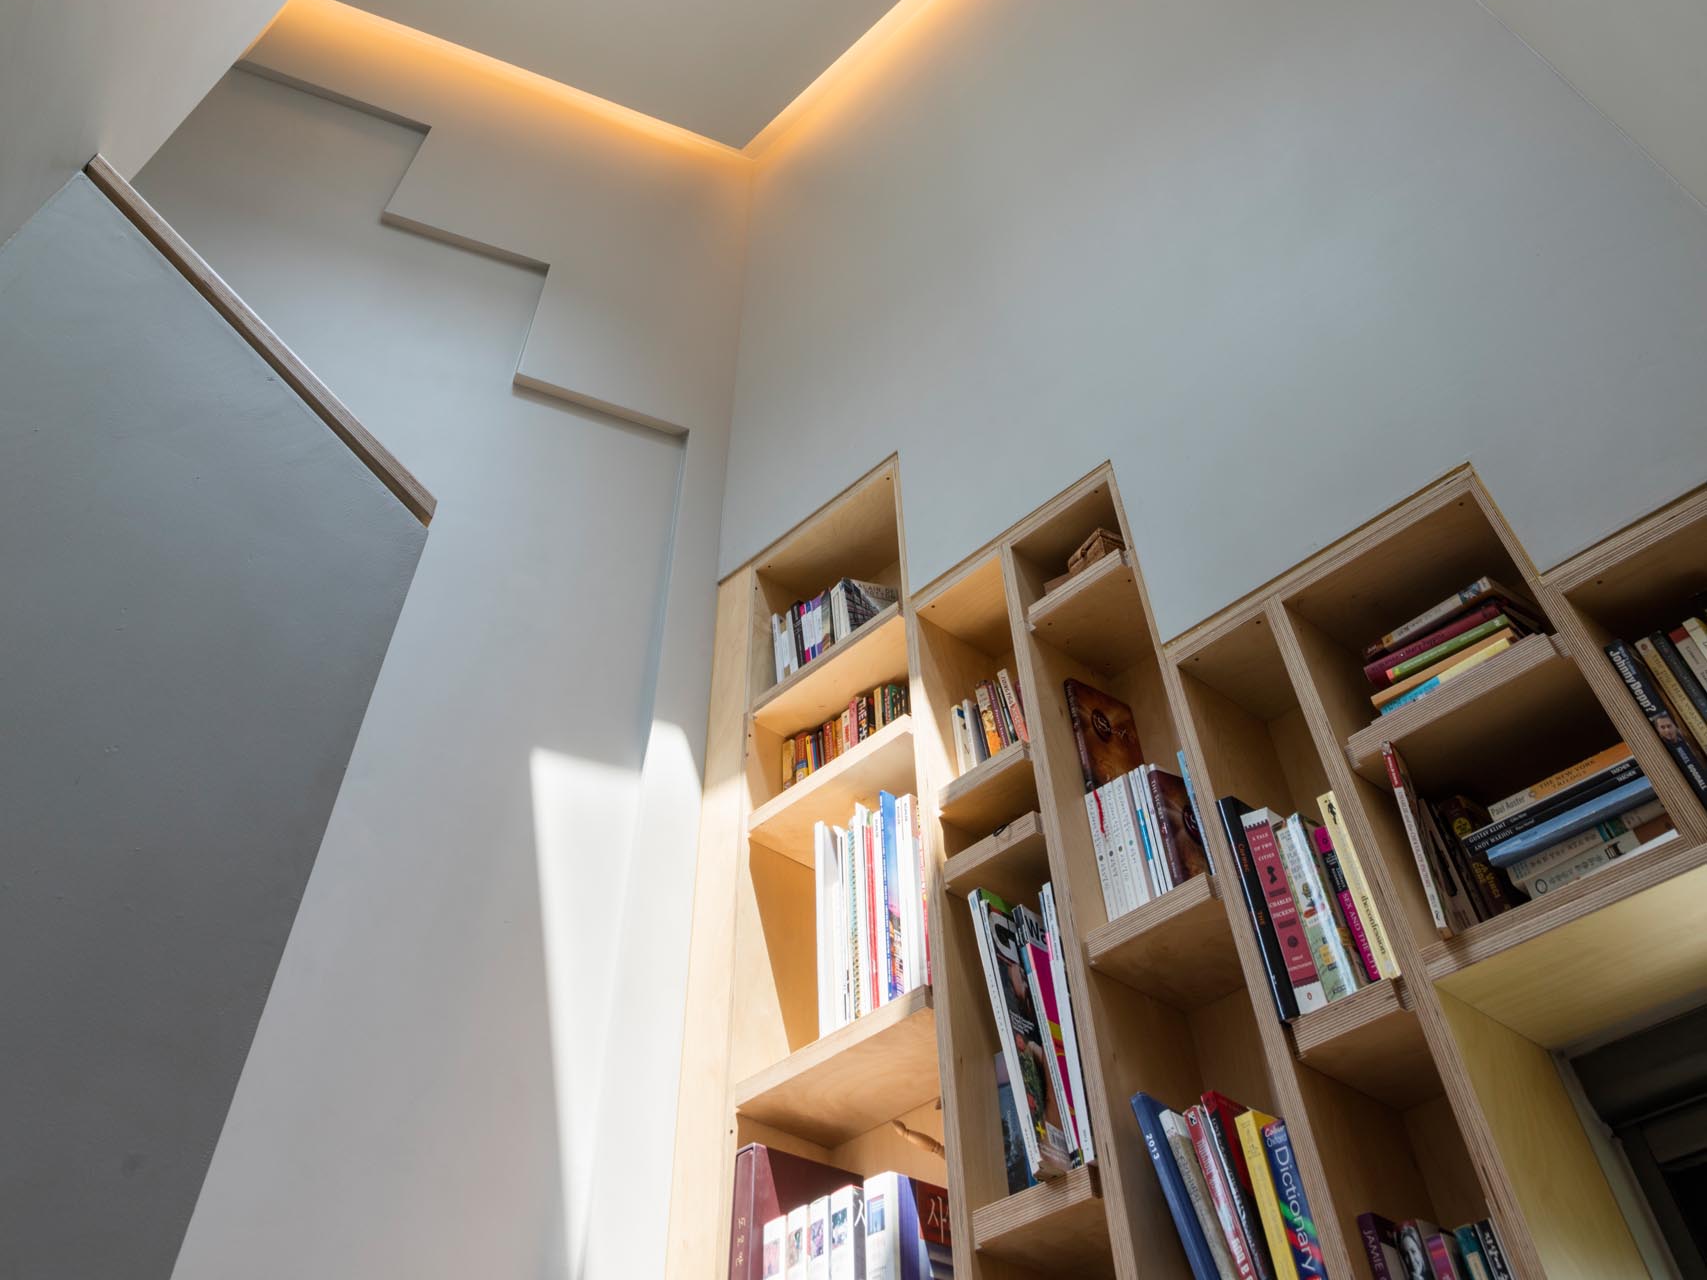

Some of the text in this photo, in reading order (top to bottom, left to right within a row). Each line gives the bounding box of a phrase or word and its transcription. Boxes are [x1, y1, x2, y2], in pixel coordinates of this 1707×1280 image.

[1609, 650, 1656, 712] Johnny Depp?
[1555, 770, 1573, 781] NEW
[1573, 759, 1595, 771] YORK
[1154, 794, 1165, 820] SECRET
[1490, 795, 1526, 817] Paul Auster
[1469, 829, 1490, 843] GUSTAV
[1490, 821, 1506, 832] KLIMT
[1474, 829, 1514, 851] ANDY WARHOL
[1258, 852, 1275, 861] CITIES
[1269, 896, 1292, 907] CHARLES
[1342, 893, 1353, 909] SEX
[1349, 911, 1361, 932] AND
[1357, 932, 1370, 952] THE
[1367, 953, 1379, 976] CITY
[1145, 1132, 1160, 1161] 2013
[1275, 1146, 1316, 1271] Dictionary
[1362, 1229, 1385, 1272] JAMIE
